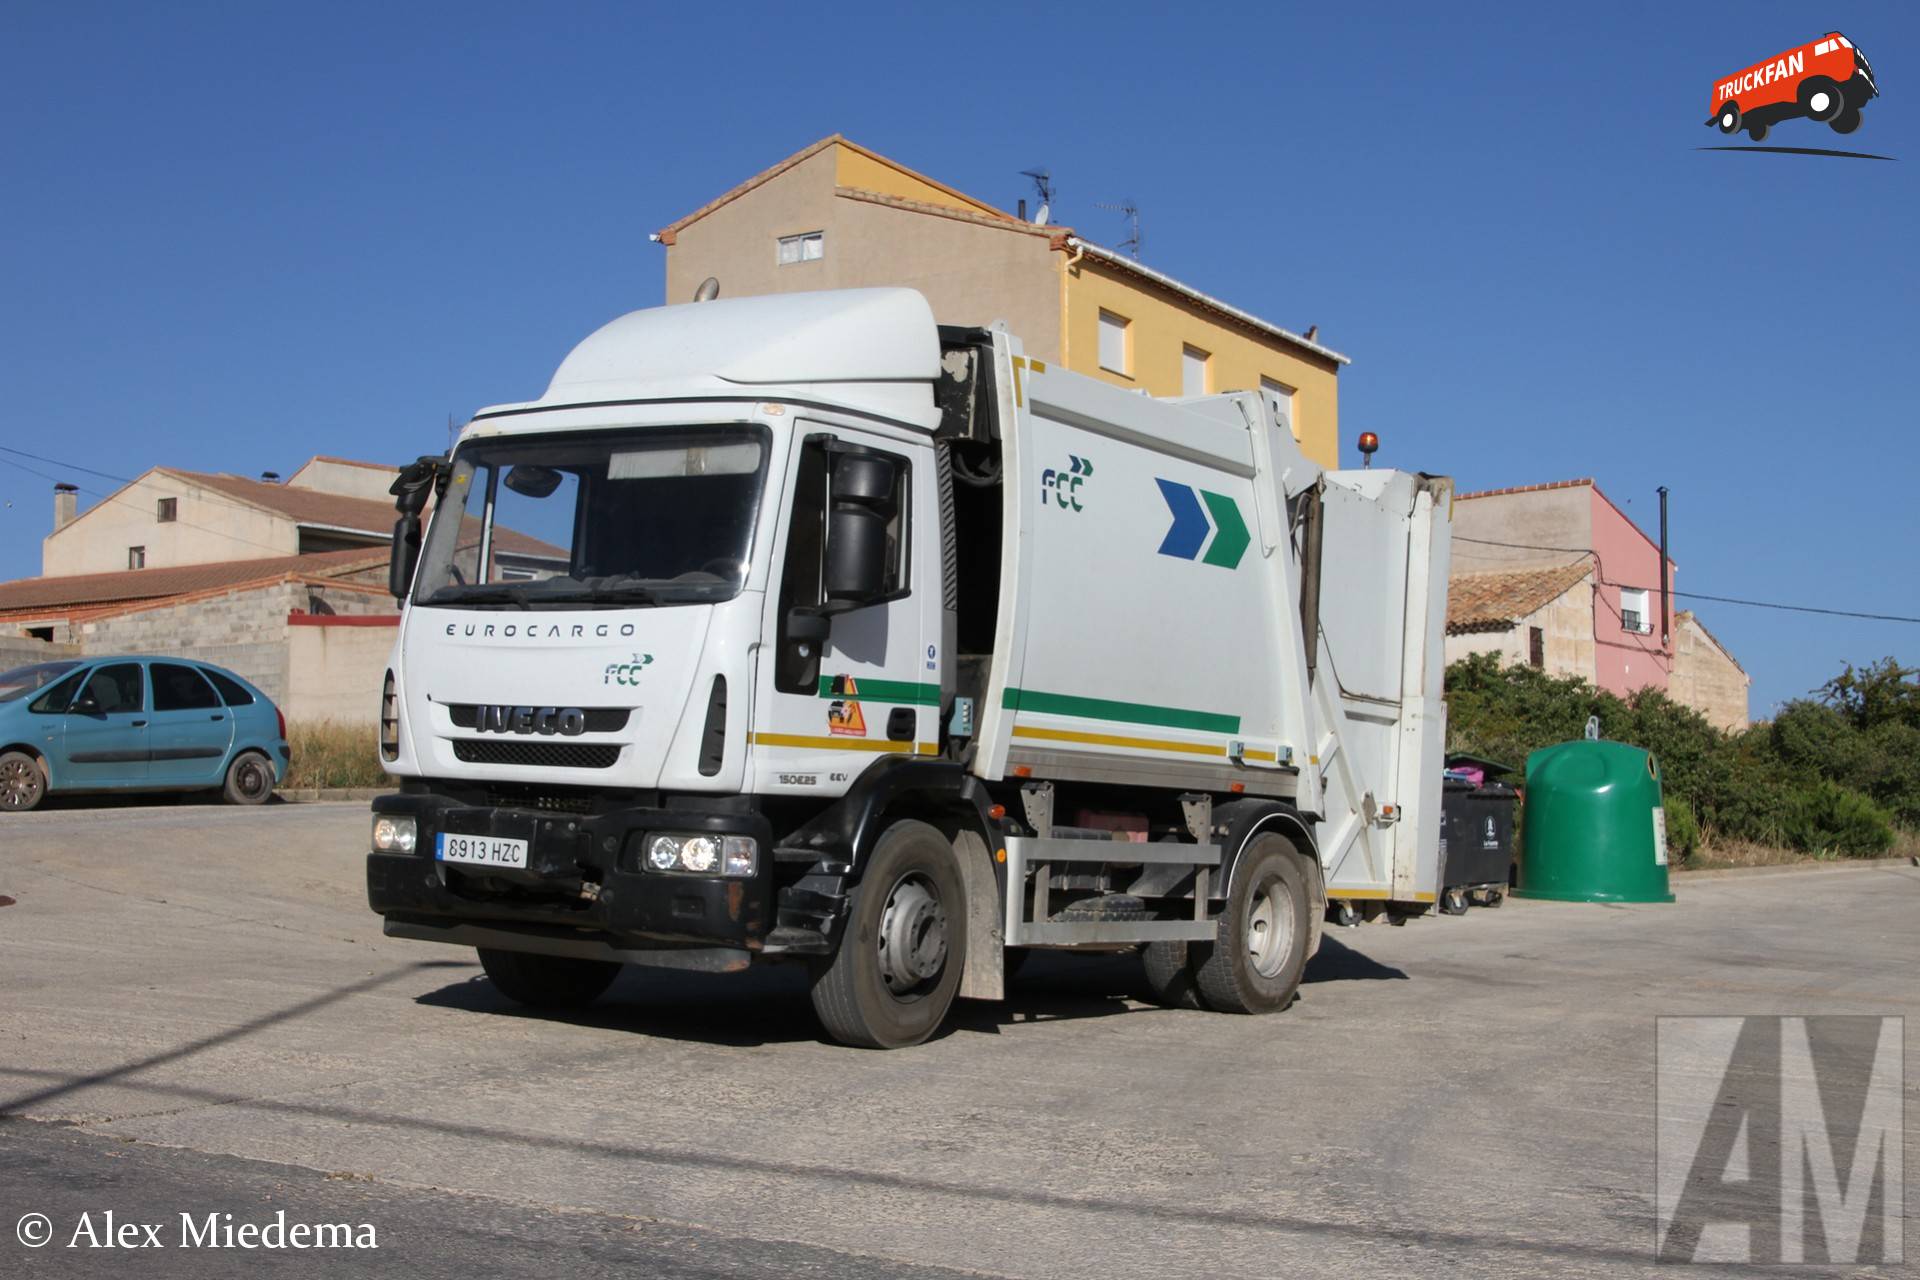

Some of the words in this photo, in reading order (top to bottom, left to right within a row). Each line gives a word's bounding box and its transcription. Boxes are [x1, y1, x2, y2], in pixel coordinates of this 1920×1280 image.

[1042, 468, 1083, 512] FCC
[446, 624, 635, 638] EUROCARGO
[604, 664, 642, 686] FCC
[476, 704, 585, 736] IVECO
[779, 774, 816, 785] 150E25
[829, 772, 848, 782] EEV
[449, 839, 486, 860] 8913
[491, 842, 521, 863] HZC
